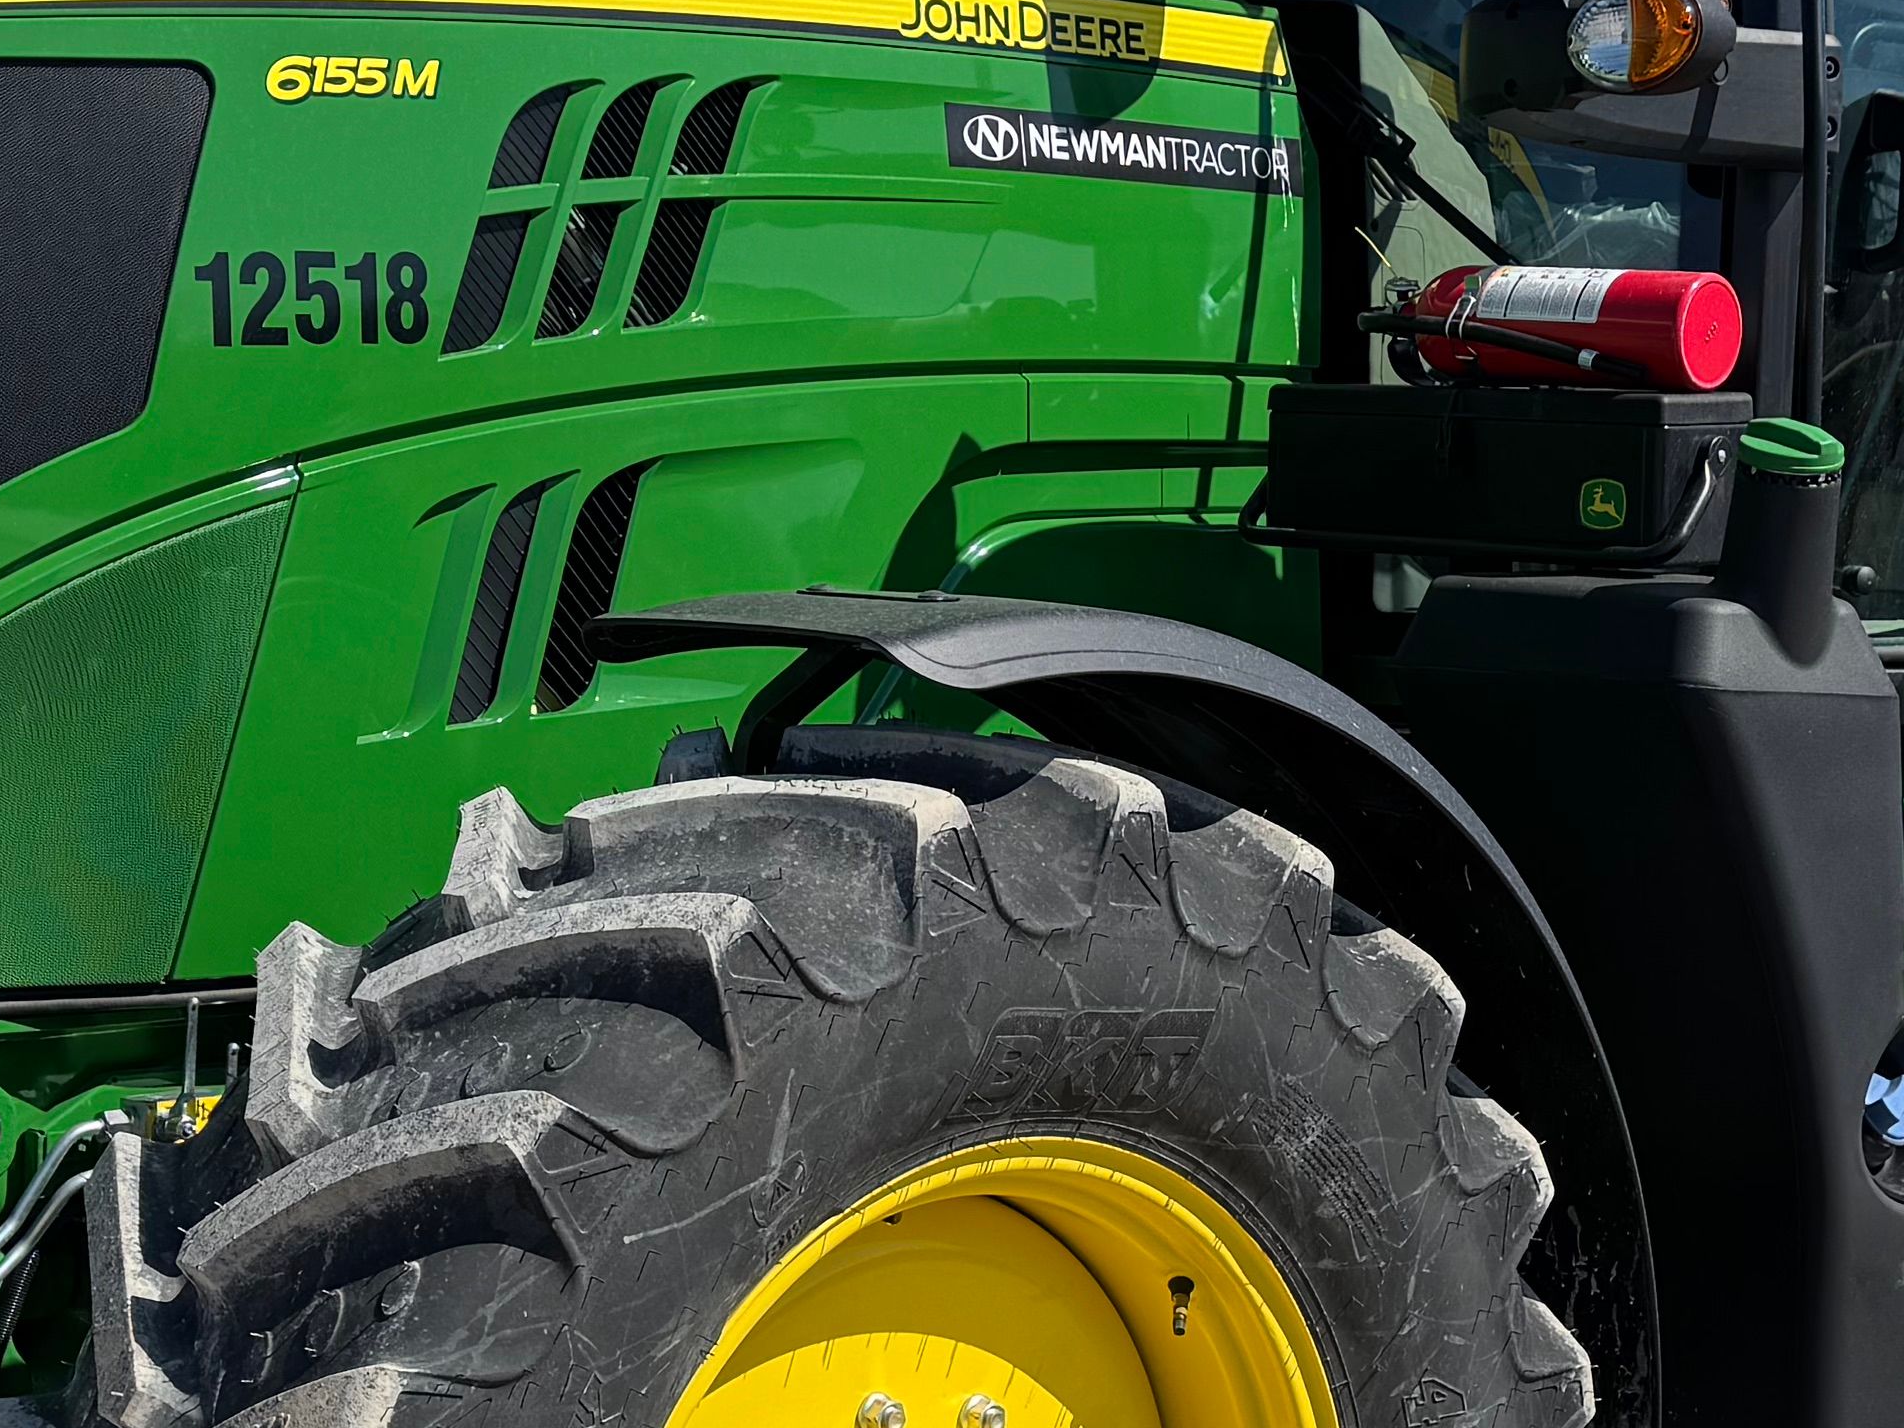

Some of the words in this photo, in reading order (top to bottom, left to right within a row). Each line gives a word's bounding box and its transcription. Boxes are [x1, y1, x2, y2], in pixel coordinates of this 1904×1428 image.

[1018, 0, 1146, 56] DEERE
[194, 250, 429, 347] 12518
[956, 1027, 1208, 1116] BKT
